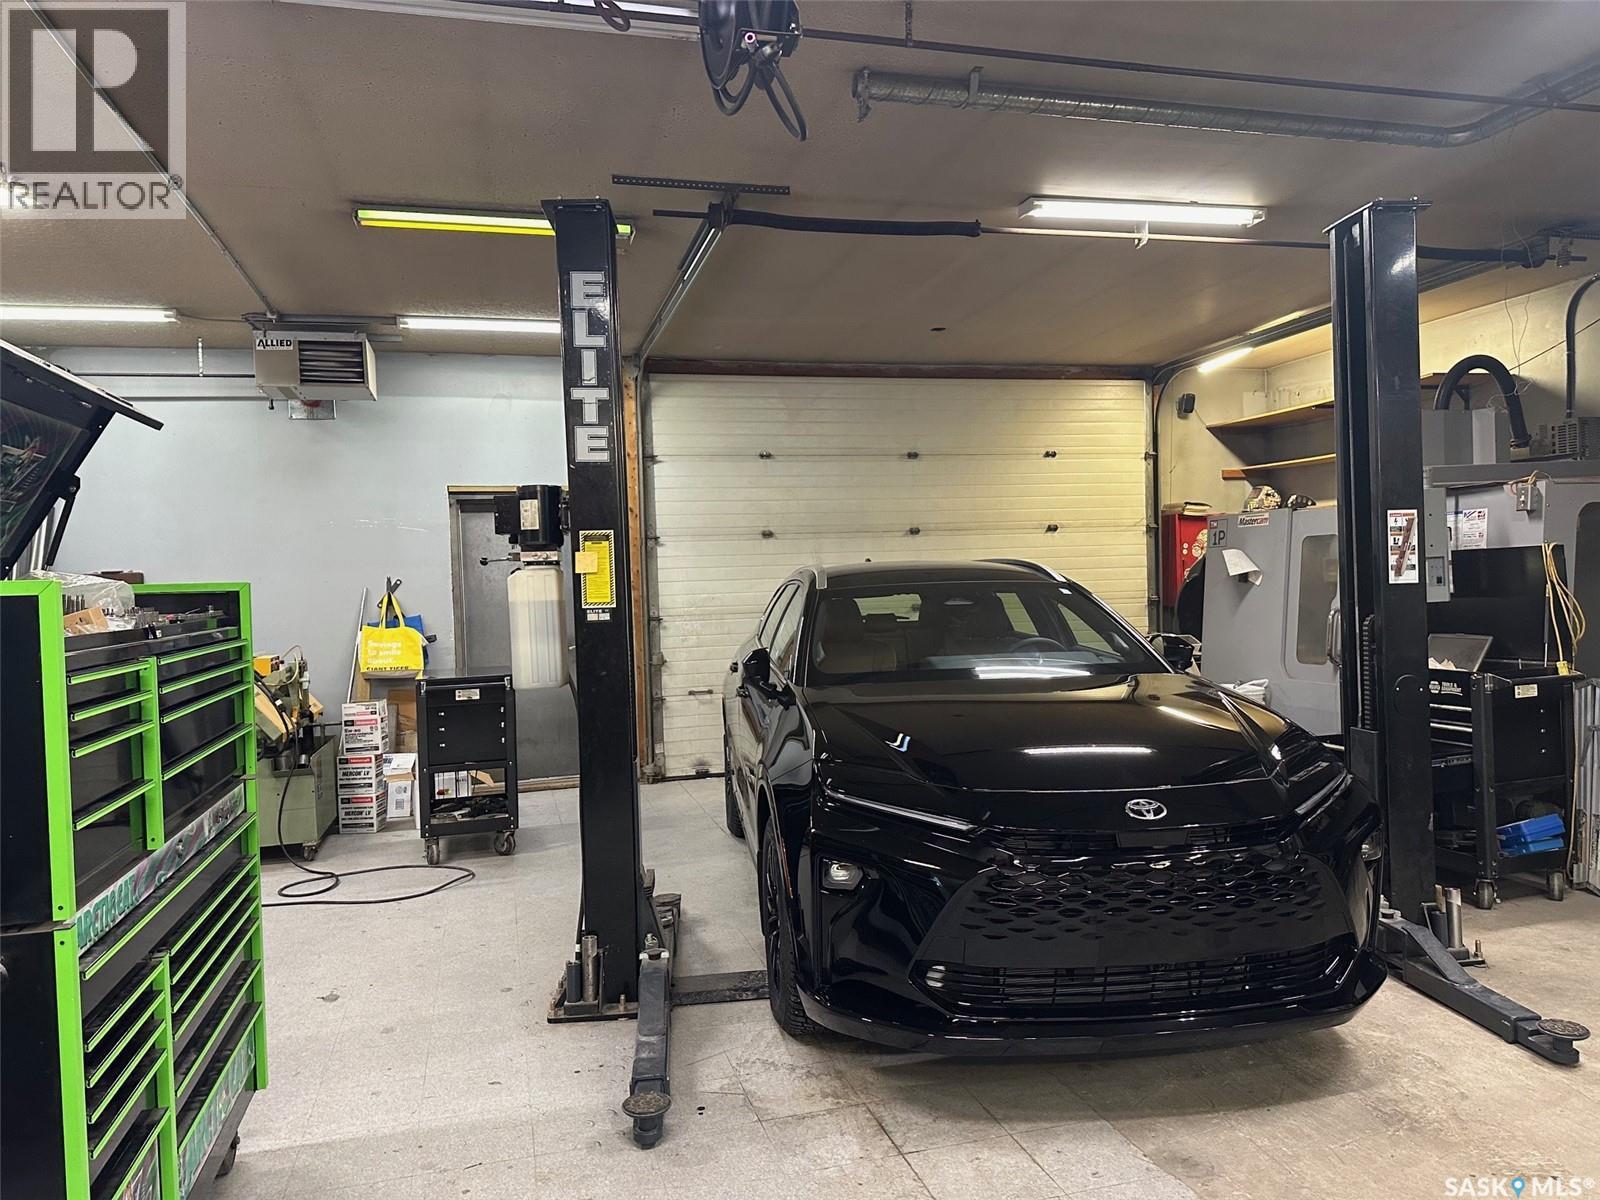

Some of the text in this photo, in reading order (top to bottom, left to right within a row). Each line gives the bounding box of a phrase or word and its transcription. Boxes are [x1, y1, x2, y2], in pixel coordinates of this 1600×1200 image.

[257, 339, 292, 349] ALLIED
[570, 271, 610, 463] ELITE
[1239, 517, 1269, 526] Mastercam
